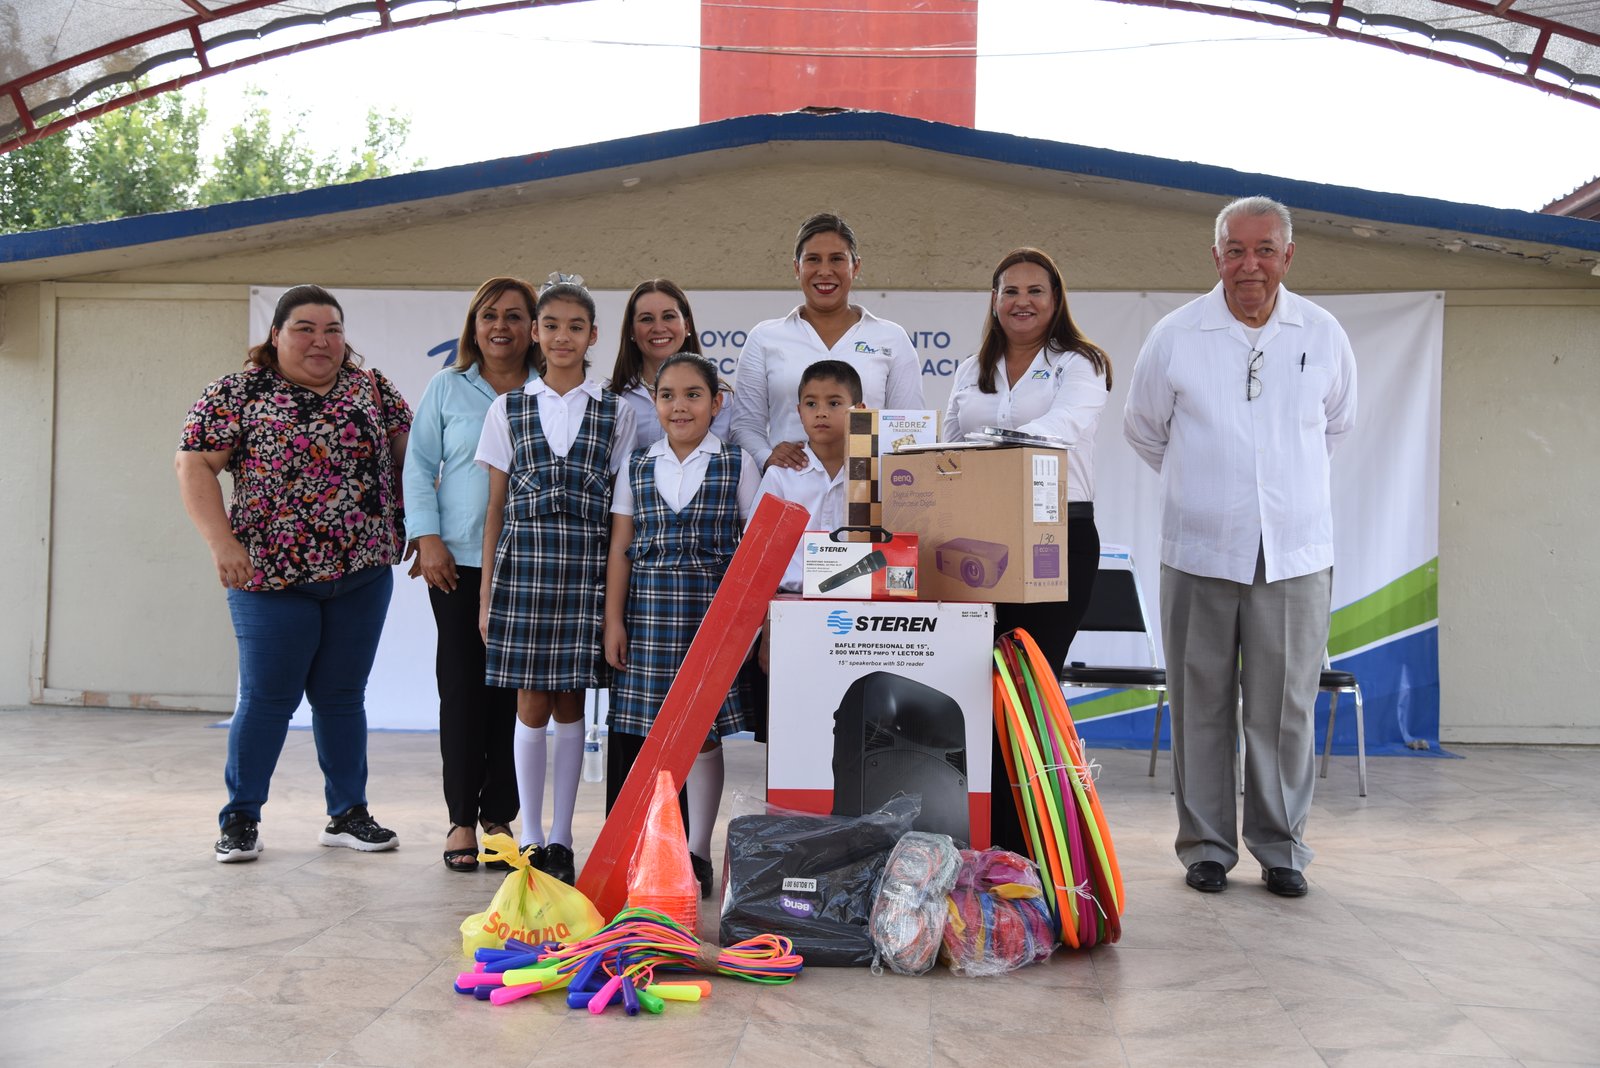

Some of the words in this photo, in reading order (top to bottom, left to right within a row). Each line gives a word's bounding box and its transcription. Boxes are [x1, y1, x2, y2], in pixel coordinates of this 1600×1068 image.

[701, 331, 747, 347] OYO
[910, 331, 951, 349] NTO
[893, 491, 908, 499] Digital
[909, 491, 934, 499] Projector
[855, 616, 938, 632] STEREN
[482, 911, 571, 946] Soriana
